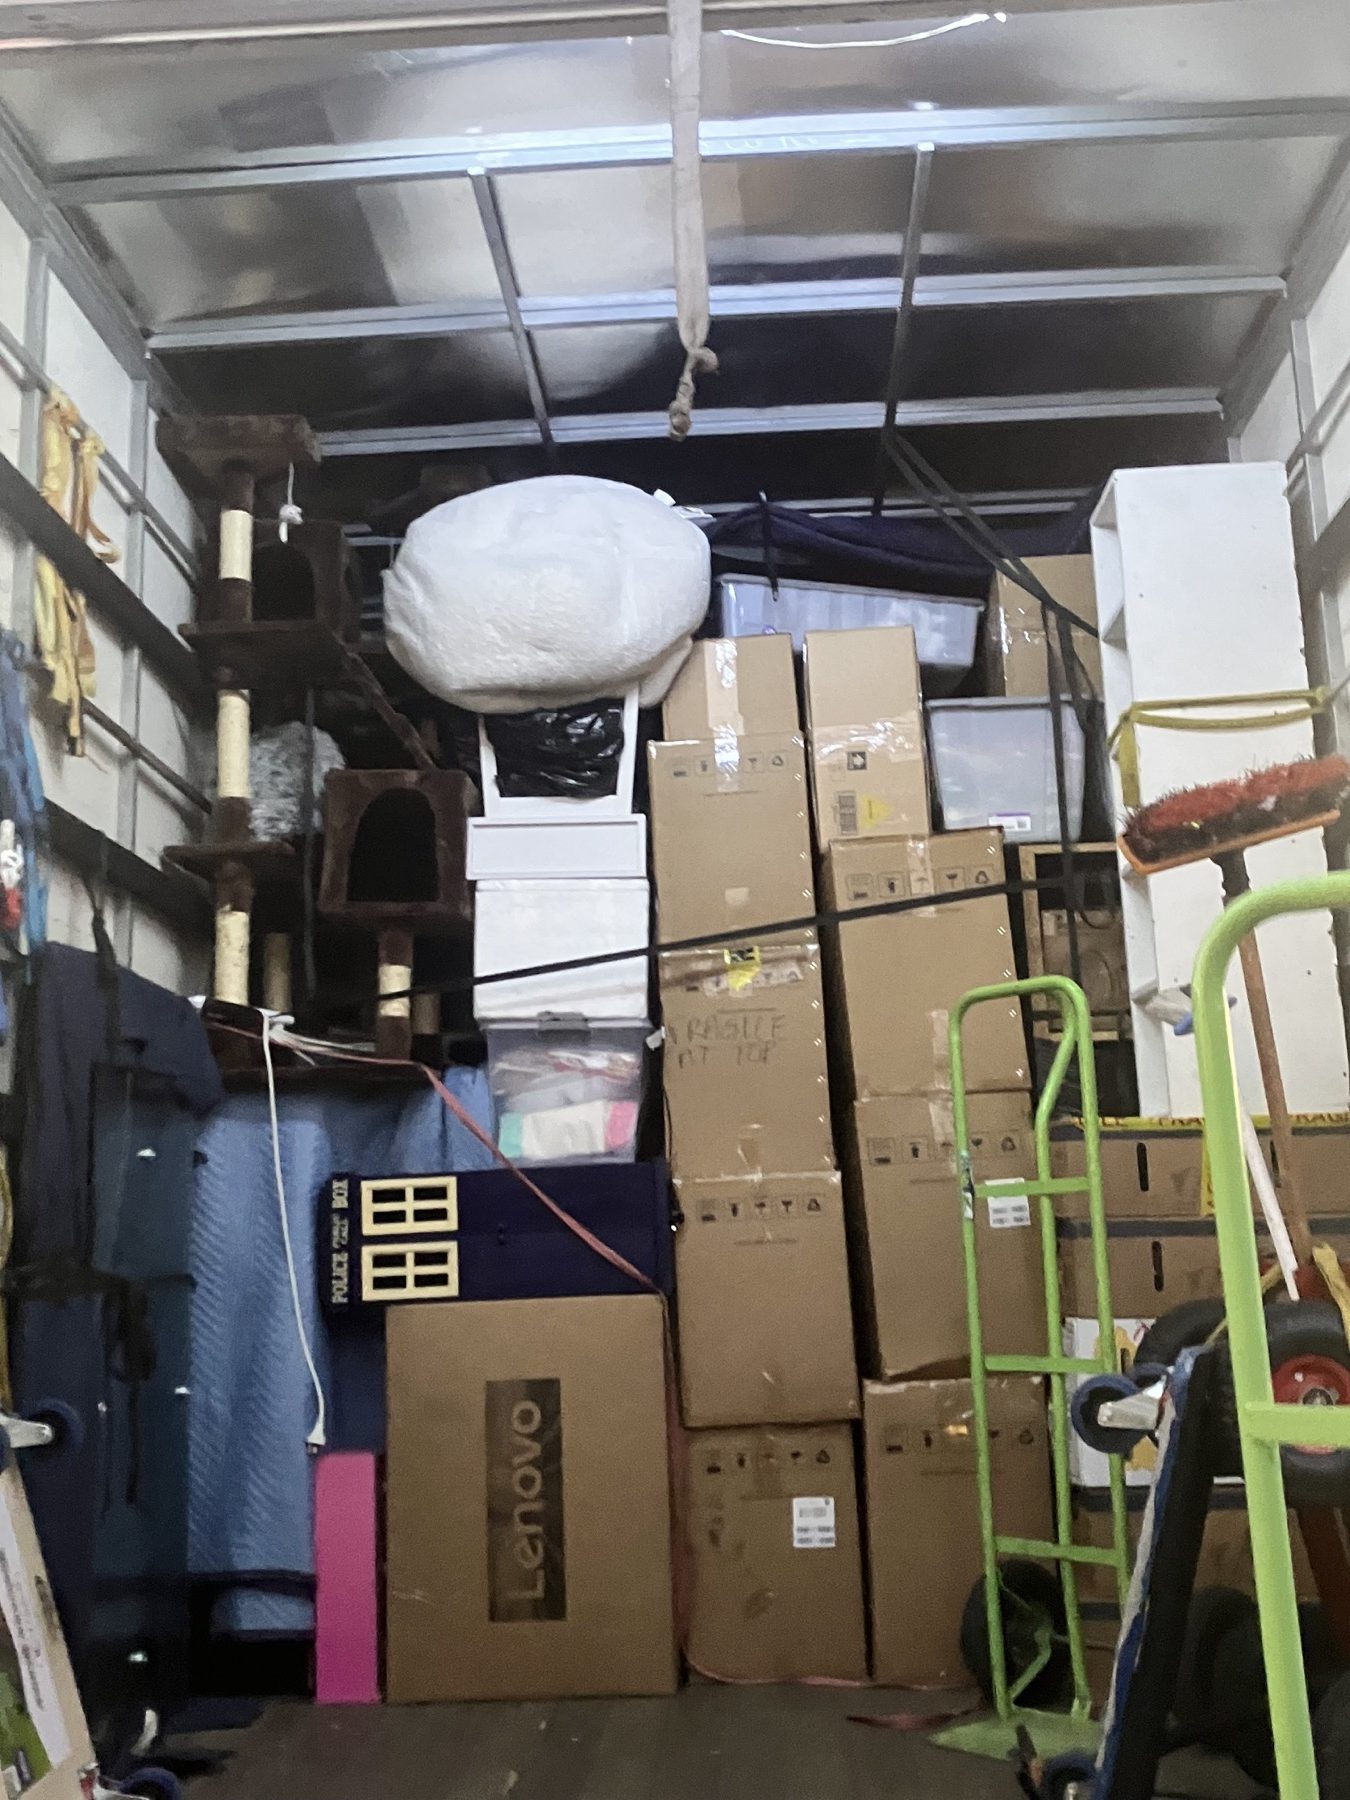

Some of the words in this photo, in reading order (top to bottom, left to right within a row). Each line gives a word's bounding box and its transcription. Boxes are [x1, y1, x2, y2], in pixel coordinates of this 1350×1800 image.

[331, 1179, 348, 1208] BOX
[331, 1252, 348, 1303] POLICE
[507, 1400, 545, 1598] Lenovo
